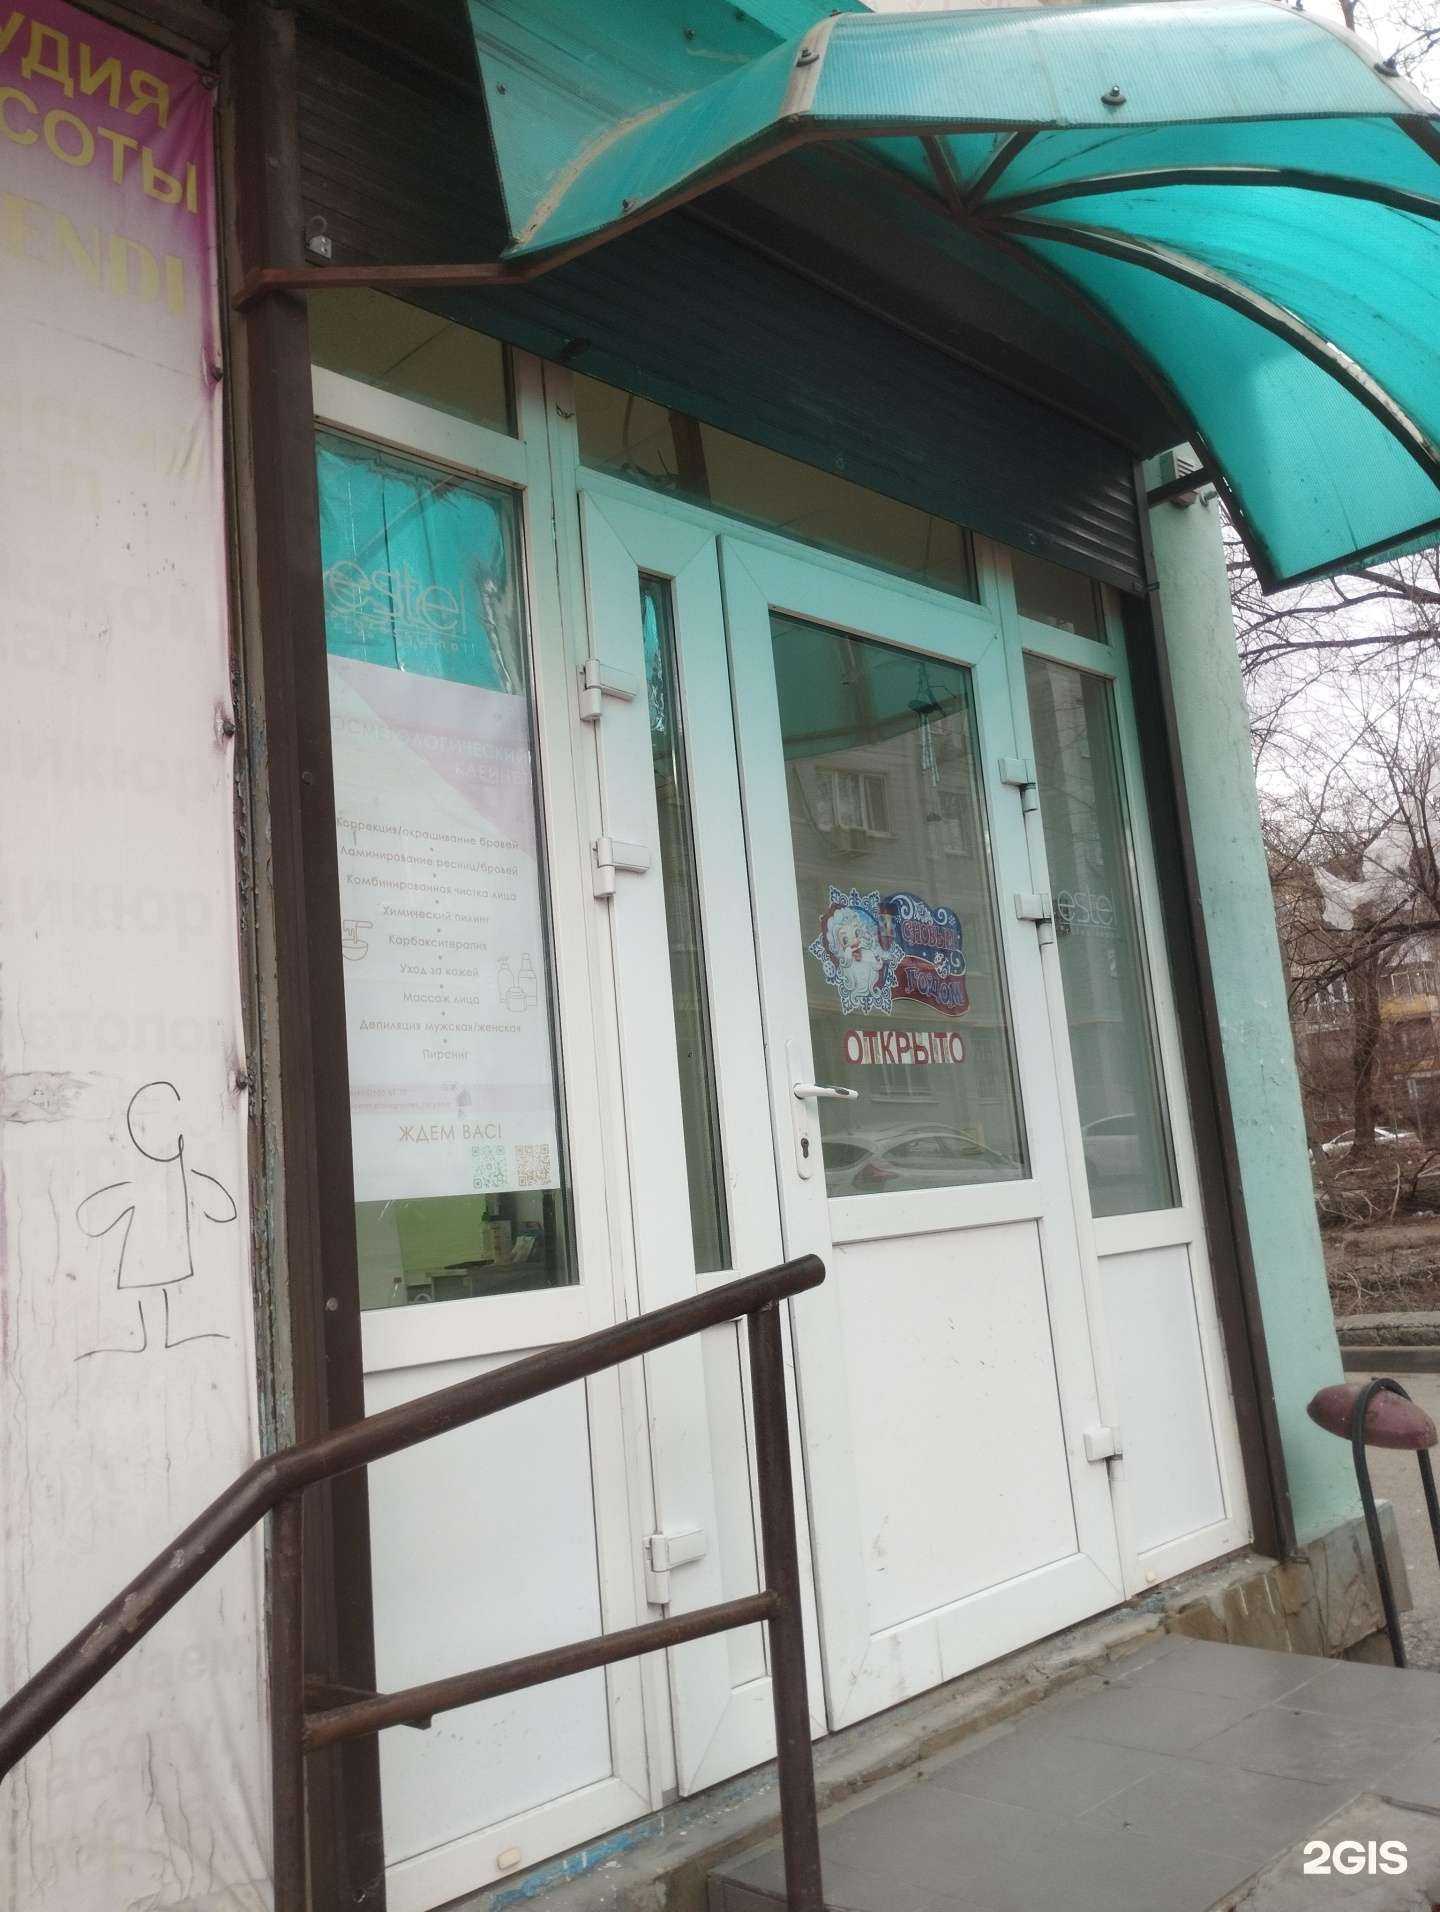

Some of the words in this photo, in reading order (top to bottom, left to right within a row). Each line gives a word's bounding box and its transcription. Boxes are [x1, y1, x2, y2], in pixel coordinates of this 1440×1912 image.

[479, 834, 519, 850] бровей
[340, 845, 433, 867] Ламинирование
[346, 874, 451, 894] Комбинированная
[454, 886, 489, 899] чистка
[492, 891, 517, 902] лица
[382, 905, 451, 921] Химический
[388, 935, 487, 951] Карбокситерапия
[399, 964, 427, 977] Уход
[431, 967, 442, 977] за
[445, 966, 479, 977] кожей
[403, 991, 450, 1004] Массаж
[455, 995, 480, 1006] лица
[359, 1019, 421, 1033] Депиляция
[425, 1021, 521, 1034] мужская/женская
[423, 1049, 469, 1061] Пирсинг
[844, 1029, 965, 1065] ОТКРЫТО
[399, 1124, 455, 1143] ЖДЕМ
[462, 1122, 502, 1140] ВАС!
